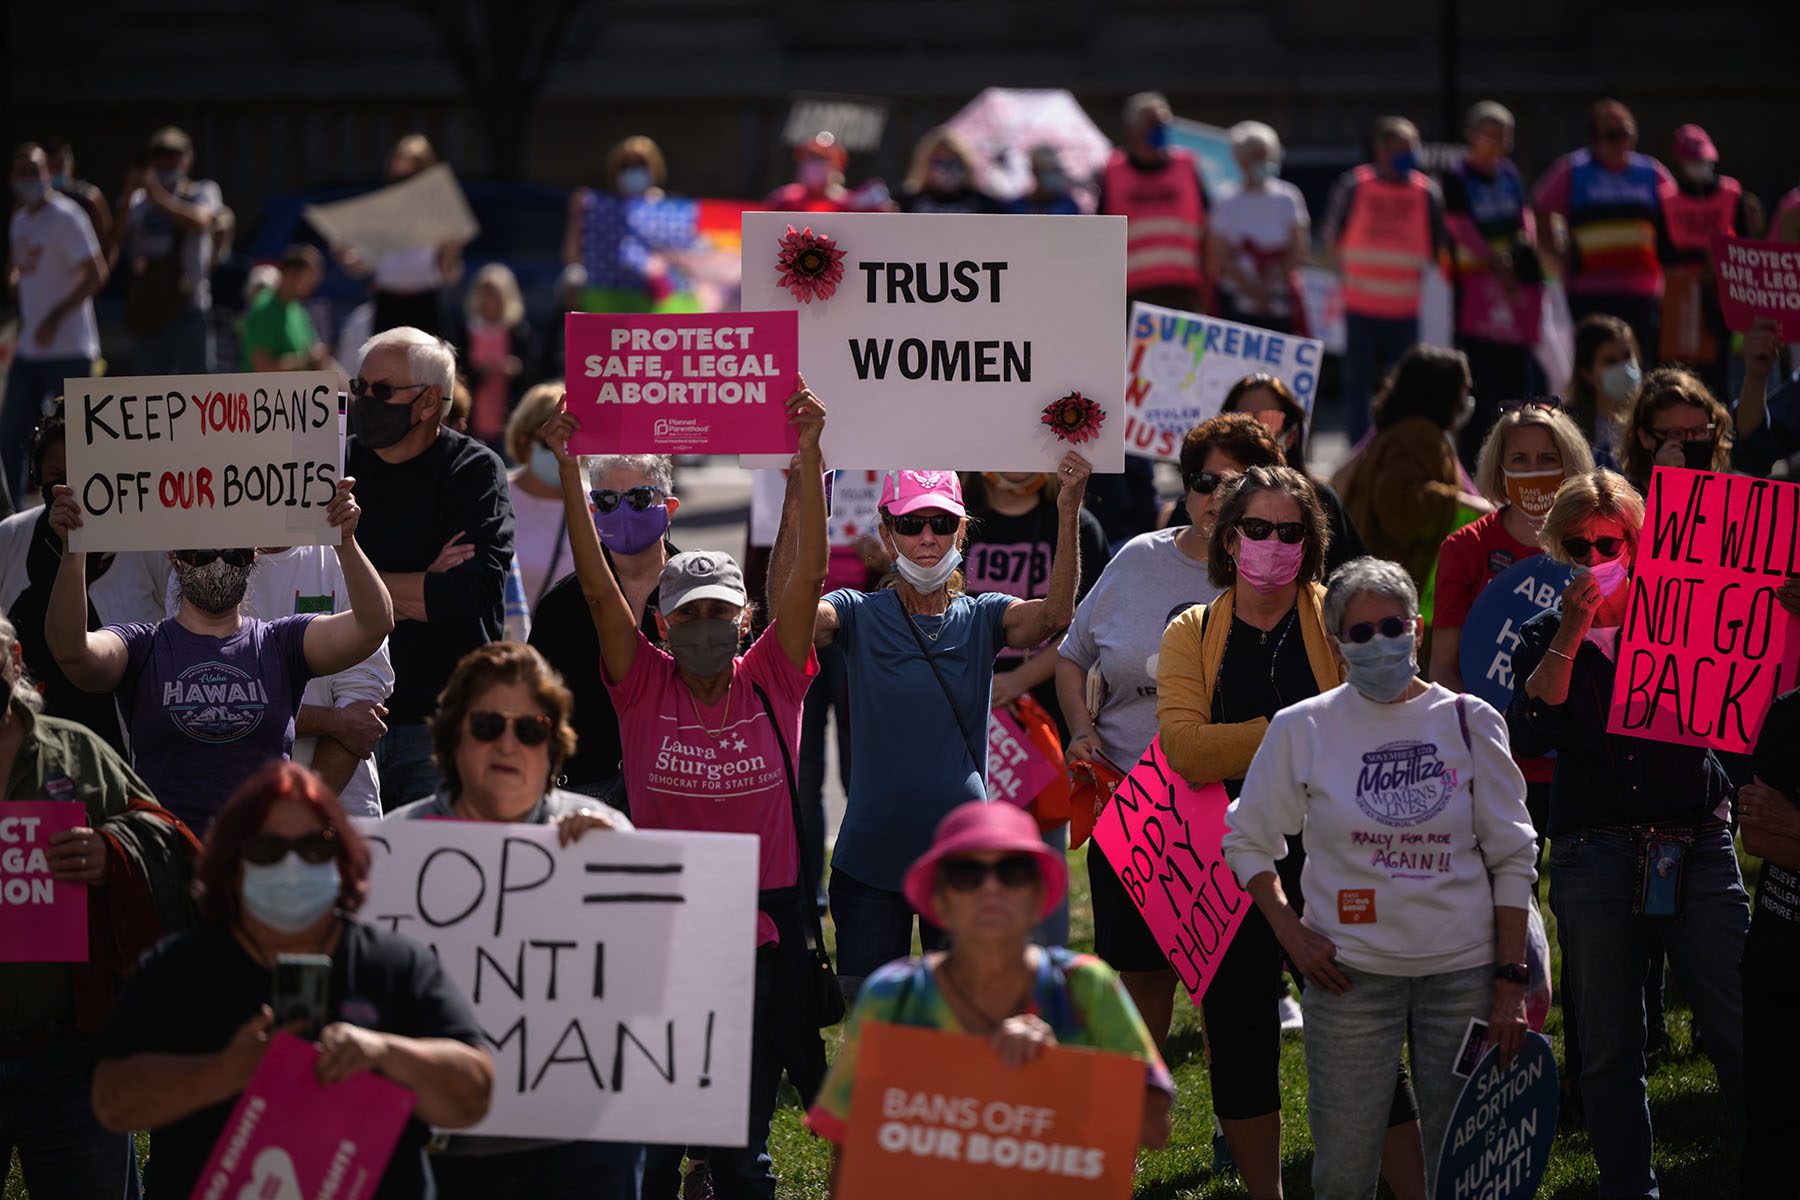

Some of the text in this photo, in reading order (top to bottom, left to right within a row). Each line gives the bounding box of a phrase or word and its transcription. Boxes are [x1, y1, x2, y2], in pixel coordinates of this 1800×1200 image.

[859, 261, 1008, 303] TRUST
[1763, 268, 1800, 290] LEG
[611, 327, 754, 350] PROTECT
[1135, 313, 1285, 366] SUPREME
[584, 354, 780, 380] SAFE, LEGAL
[848, 338, 1031, 382] WOMEN
[596, 382, 767, 404] ABORTION
[84, 385, 329, 445] KEEP YOUR BANS
[83, 461, 337, 516] OFF OUR BODIES
[1652, 471, 1800, 578] WE WILL
[1628, 575, 1775, 660] NOT GO
[162, 679, 269, 706] HAWAII
[199, 673, 227, 684] Aloha
[655, 751, 767, 781] Sturgeon
[661, 736, 717, 760] Laura
[1366, 750, 1416, 763] NOVEMBER
[649, 773, 697, 789] DEMOCRAT
[702, 780, 721, 790] FOR
[725, 777, 754, 790] STATE
[1114, 743, 1167, 842] MY
[1356, 757, 1446, 797] Mobilize
[1386, 800, 1428, 817] LIVES
[1121, 784, 1183, 908] BODY
[1351, 831, 1452, 850] RALLY FOR ROE
[1158, 820, 1204, 919] MY
[1761, 895, 1792, 920] INSPIRE
[1476, 1055, 1519, 1100] SAE
[882, 1087, 1056, 1138] BANS OFF
[1452, 1055, 1543, 1157] ABORTION
[877, 1121, 1105, 1180] OUR BODIES
[1485, 1117, 1507, 1146] IS A
[1455, 1107, 1538, 1200] HUMAN
